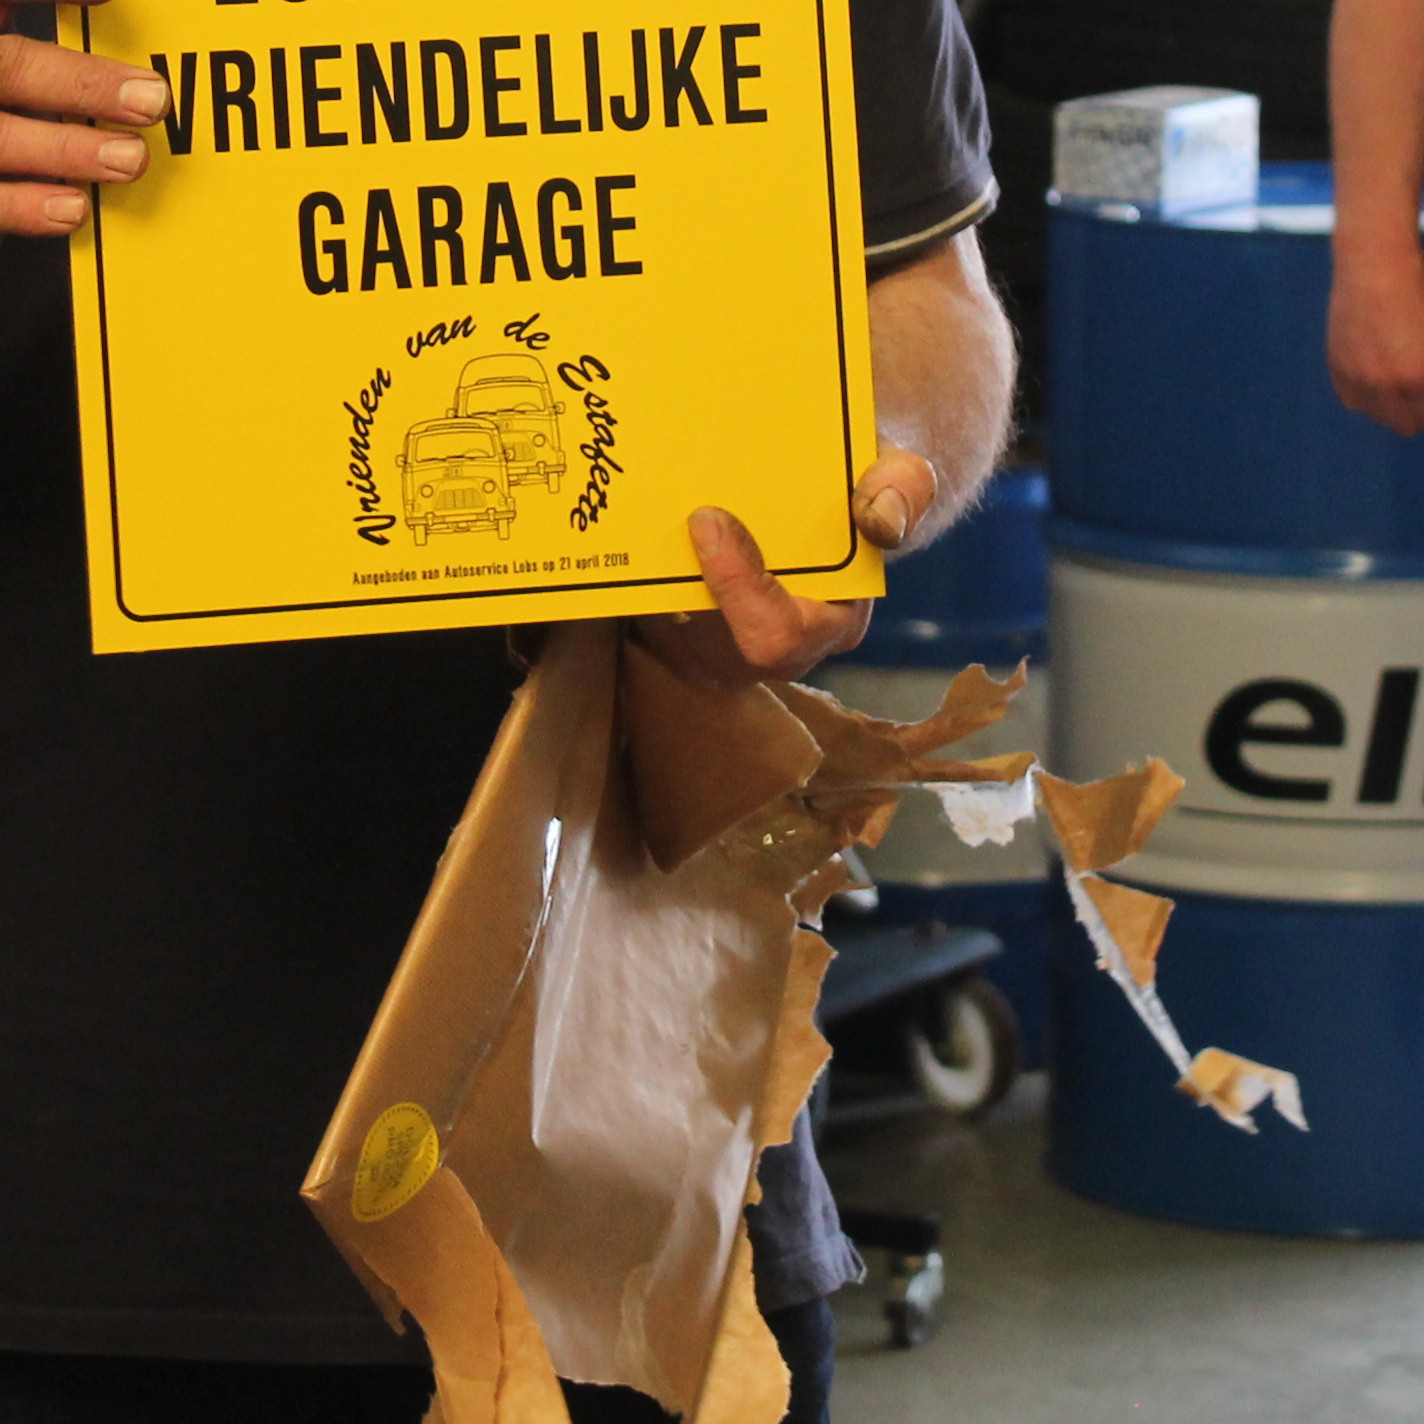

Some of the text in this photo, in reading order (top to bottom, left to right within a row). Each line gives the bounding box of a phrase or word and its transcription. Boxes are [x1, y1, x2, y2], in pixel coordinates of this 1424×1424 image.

[150, 23, 768, 155] VRIENDELIJKE
[298, 175, 643, 296] GARAGE
[343, 312, 625, 546] Vrienden van de Estafette
[352, 569, 418, 586] Aangeboden
[421, 568, 440, 580] aan
[444, 563, 509, 579] Autoservice
[542, 560, 555, 573] op
[559, 557, 571, 571] 21
[575, 554, 600, 570] april
[603, 552, 631, 567] 2018
